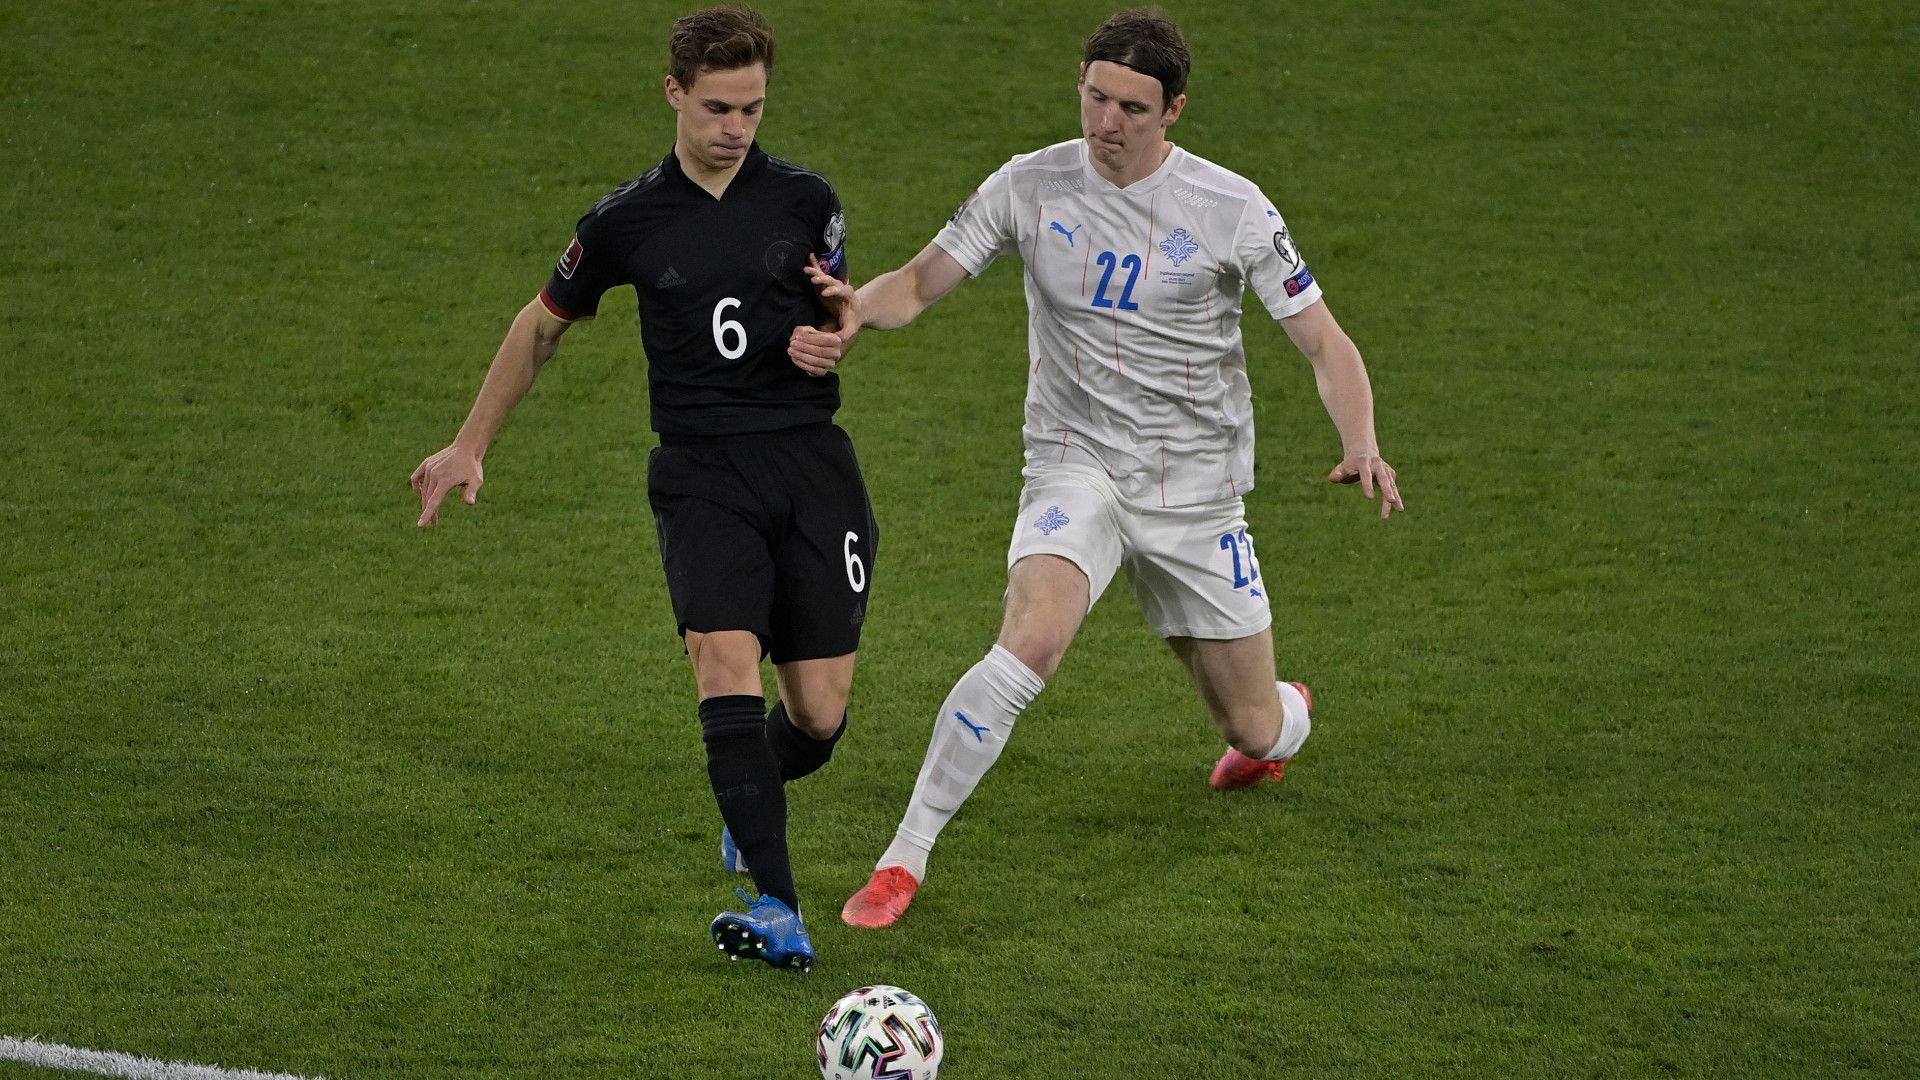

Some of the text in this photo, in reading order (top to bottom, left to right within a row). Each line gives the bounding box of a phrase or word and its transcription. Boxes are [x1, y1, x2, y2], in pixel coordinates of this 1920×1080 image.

[1091, 251, 1141, 310] 22
[712, 297, 748, 360] 6
[844, 531, 865, 593] 6
